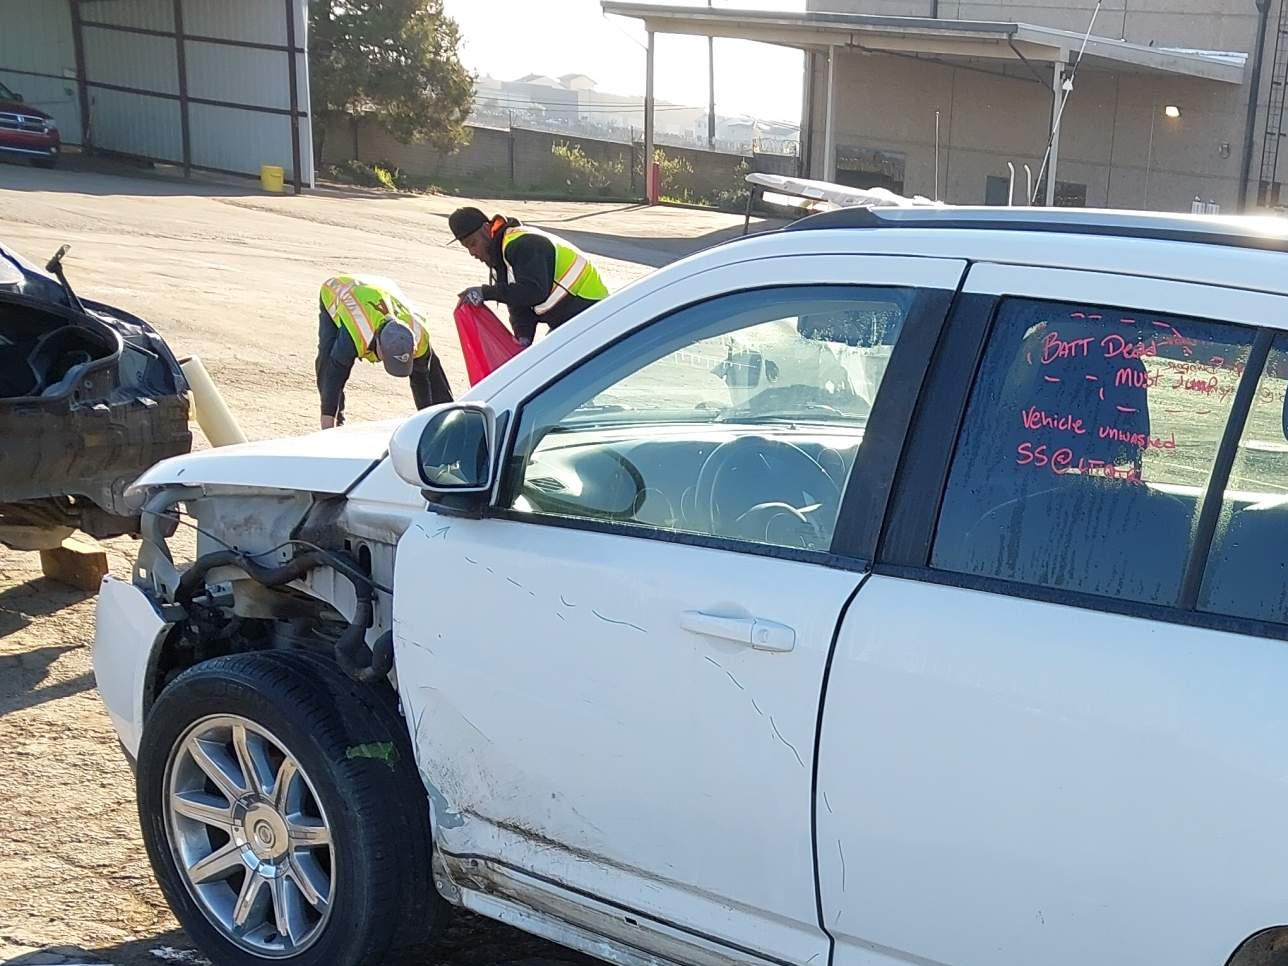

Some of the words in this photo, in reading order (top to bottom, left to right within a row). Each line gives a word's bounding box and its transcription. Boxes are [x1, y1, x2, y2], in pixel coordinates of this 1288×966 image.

[1041, 331, 1095, 364] BATT
[1101, 335, 1157, 358] Dead
[1022, 405, 1087, 434] Vehicle
